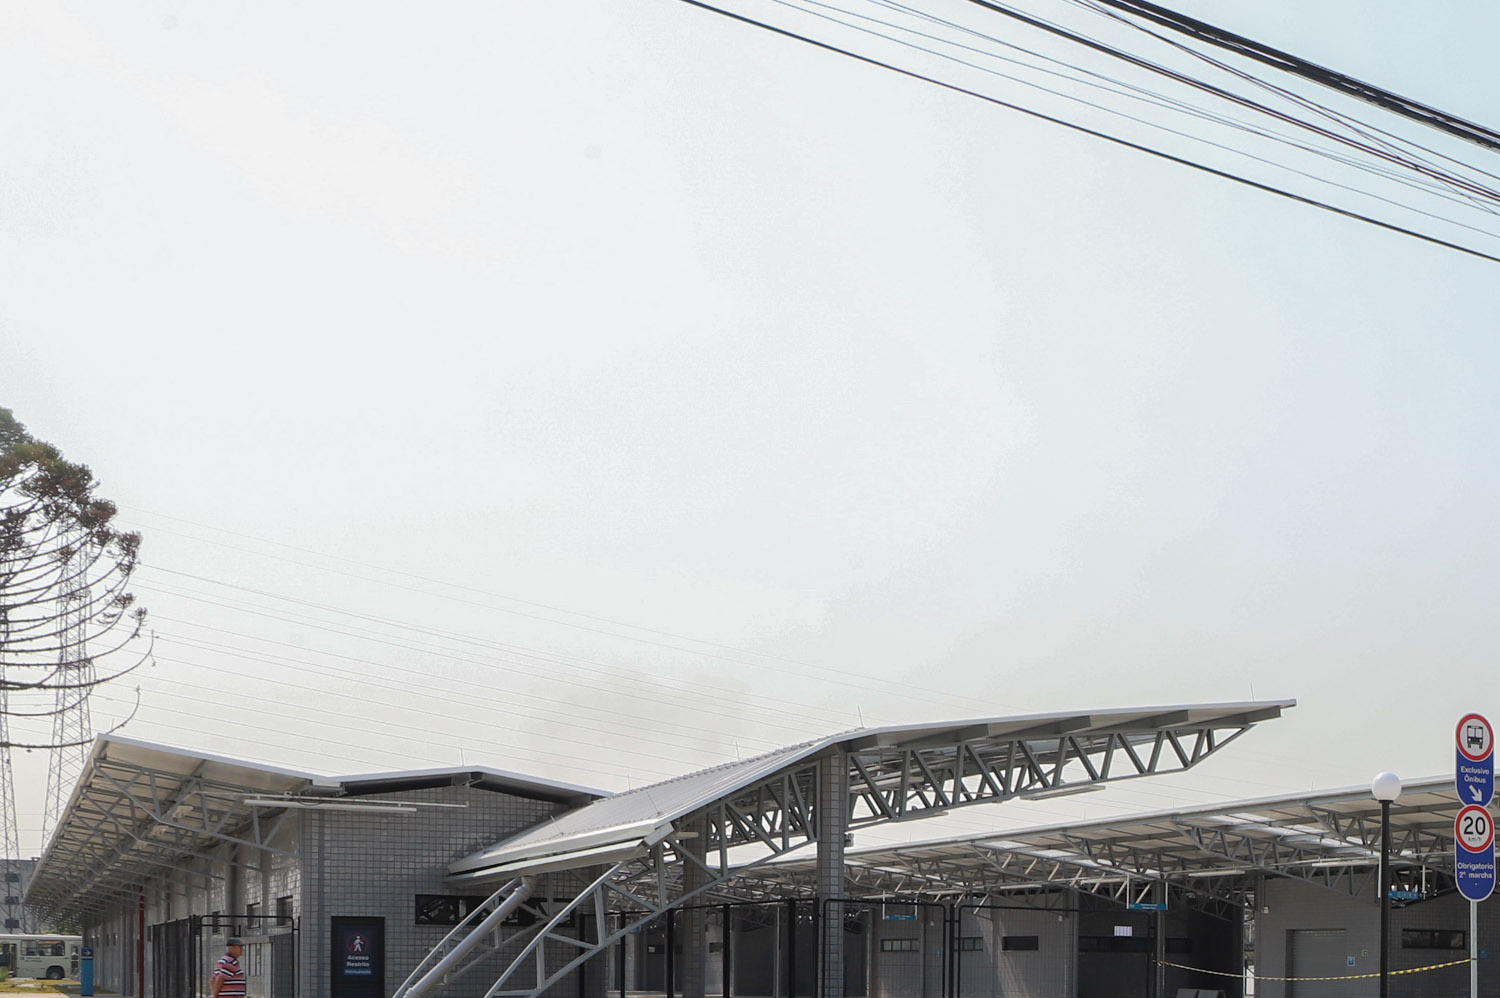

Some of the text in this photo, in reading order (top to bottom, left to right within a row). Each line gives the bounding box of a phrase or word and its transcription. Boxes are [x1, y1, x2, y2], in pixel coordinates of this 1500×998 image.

[1460, 765, 1490, 775] Exclusivo
[1464, 774, 1487, 784] Ônibus
[1463, 816, 1486, 836] 20
[1468, 871, 1493, 879] marcha
